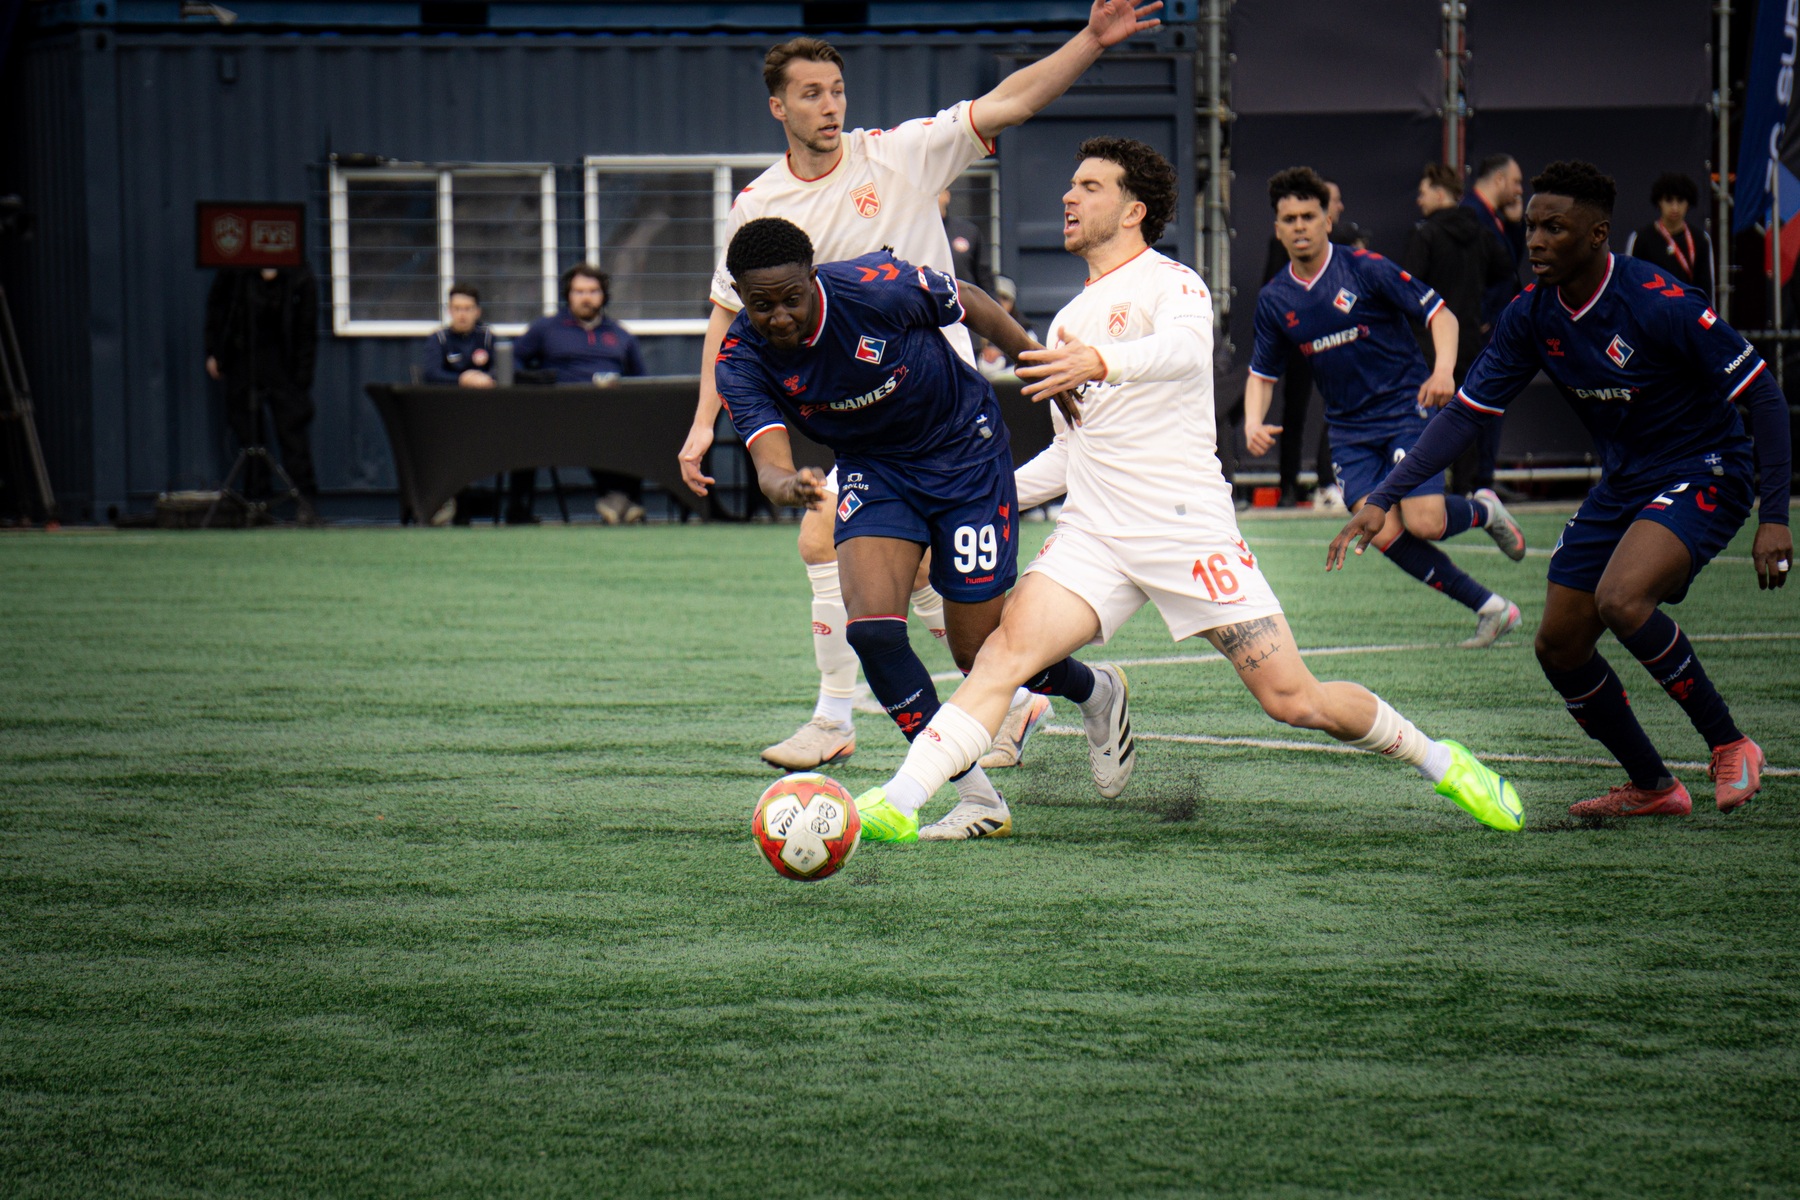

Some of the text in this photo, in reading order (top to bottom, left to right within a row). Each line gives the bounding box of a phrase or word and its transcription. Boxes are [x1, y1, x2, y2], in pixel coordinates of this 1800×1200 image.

[954, 524, 998, 573] 99
[965, 573, 994, 584] hummel
[1192, 553, 1239, 602] 16
